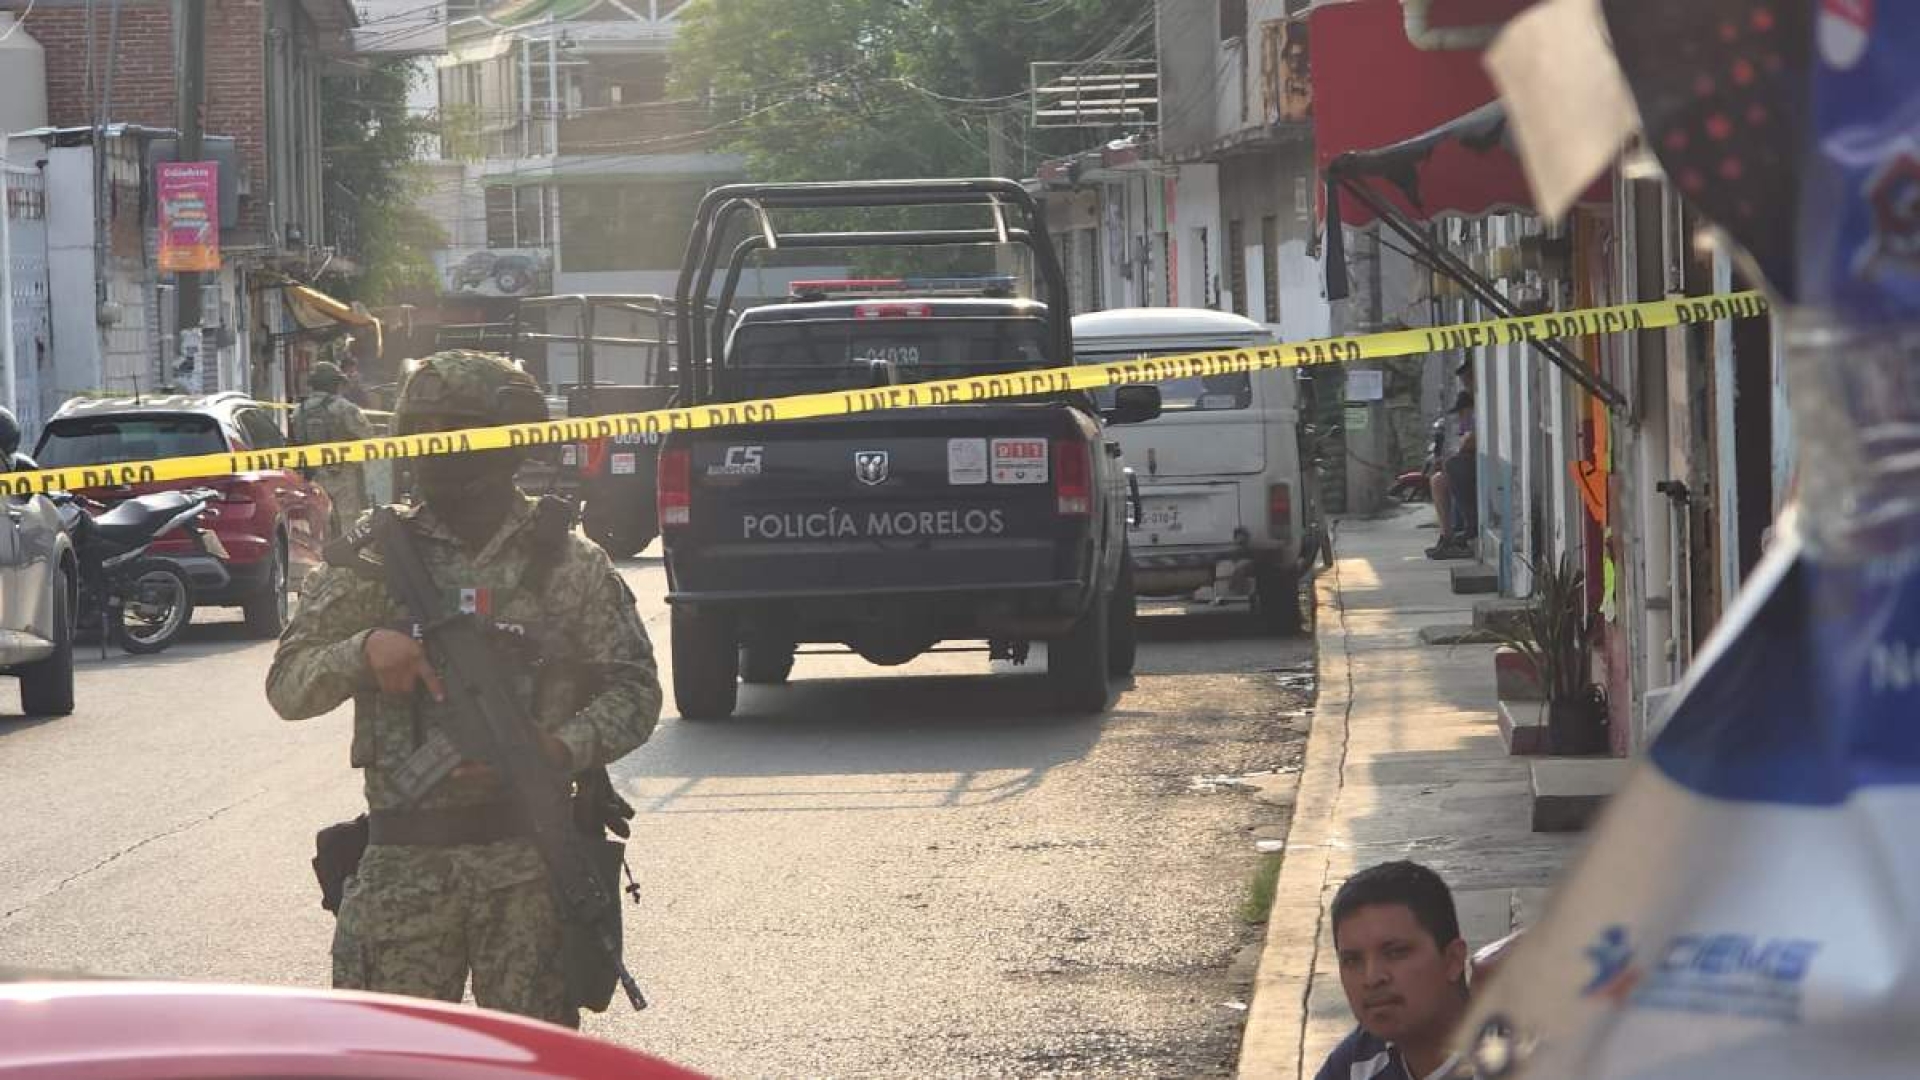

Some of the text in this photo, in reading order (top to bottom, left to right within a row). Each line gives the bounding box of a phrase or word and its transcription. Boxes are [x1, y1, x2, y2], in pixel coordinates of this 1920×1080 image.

[83, 464, 155, 488] PASO
[230, 450, 308, 473] LINEA
[321, 446, 351, 465] DE
[364, 434, 471, 461] POLICIA
[509, 417, 660, 446] PROHIBIDO
[707, 403, 776, 426] PASO
[845, 389, 918, 413] LINEA
[930, 384, 960, 405] DE
[971, 372, 1071, 399] POLICIA
[1106, 352, 1250, 385] PROHIBIDO
[1295, 341, 1362, 366] PASO
[1427, 325, 1498, 351] LINEA
[1508, 320, 1538, 343] DE
[1545, 308, 1644, 339] POLICIA
[743, 506, 1004, 538] POLICÍA MORELOS
